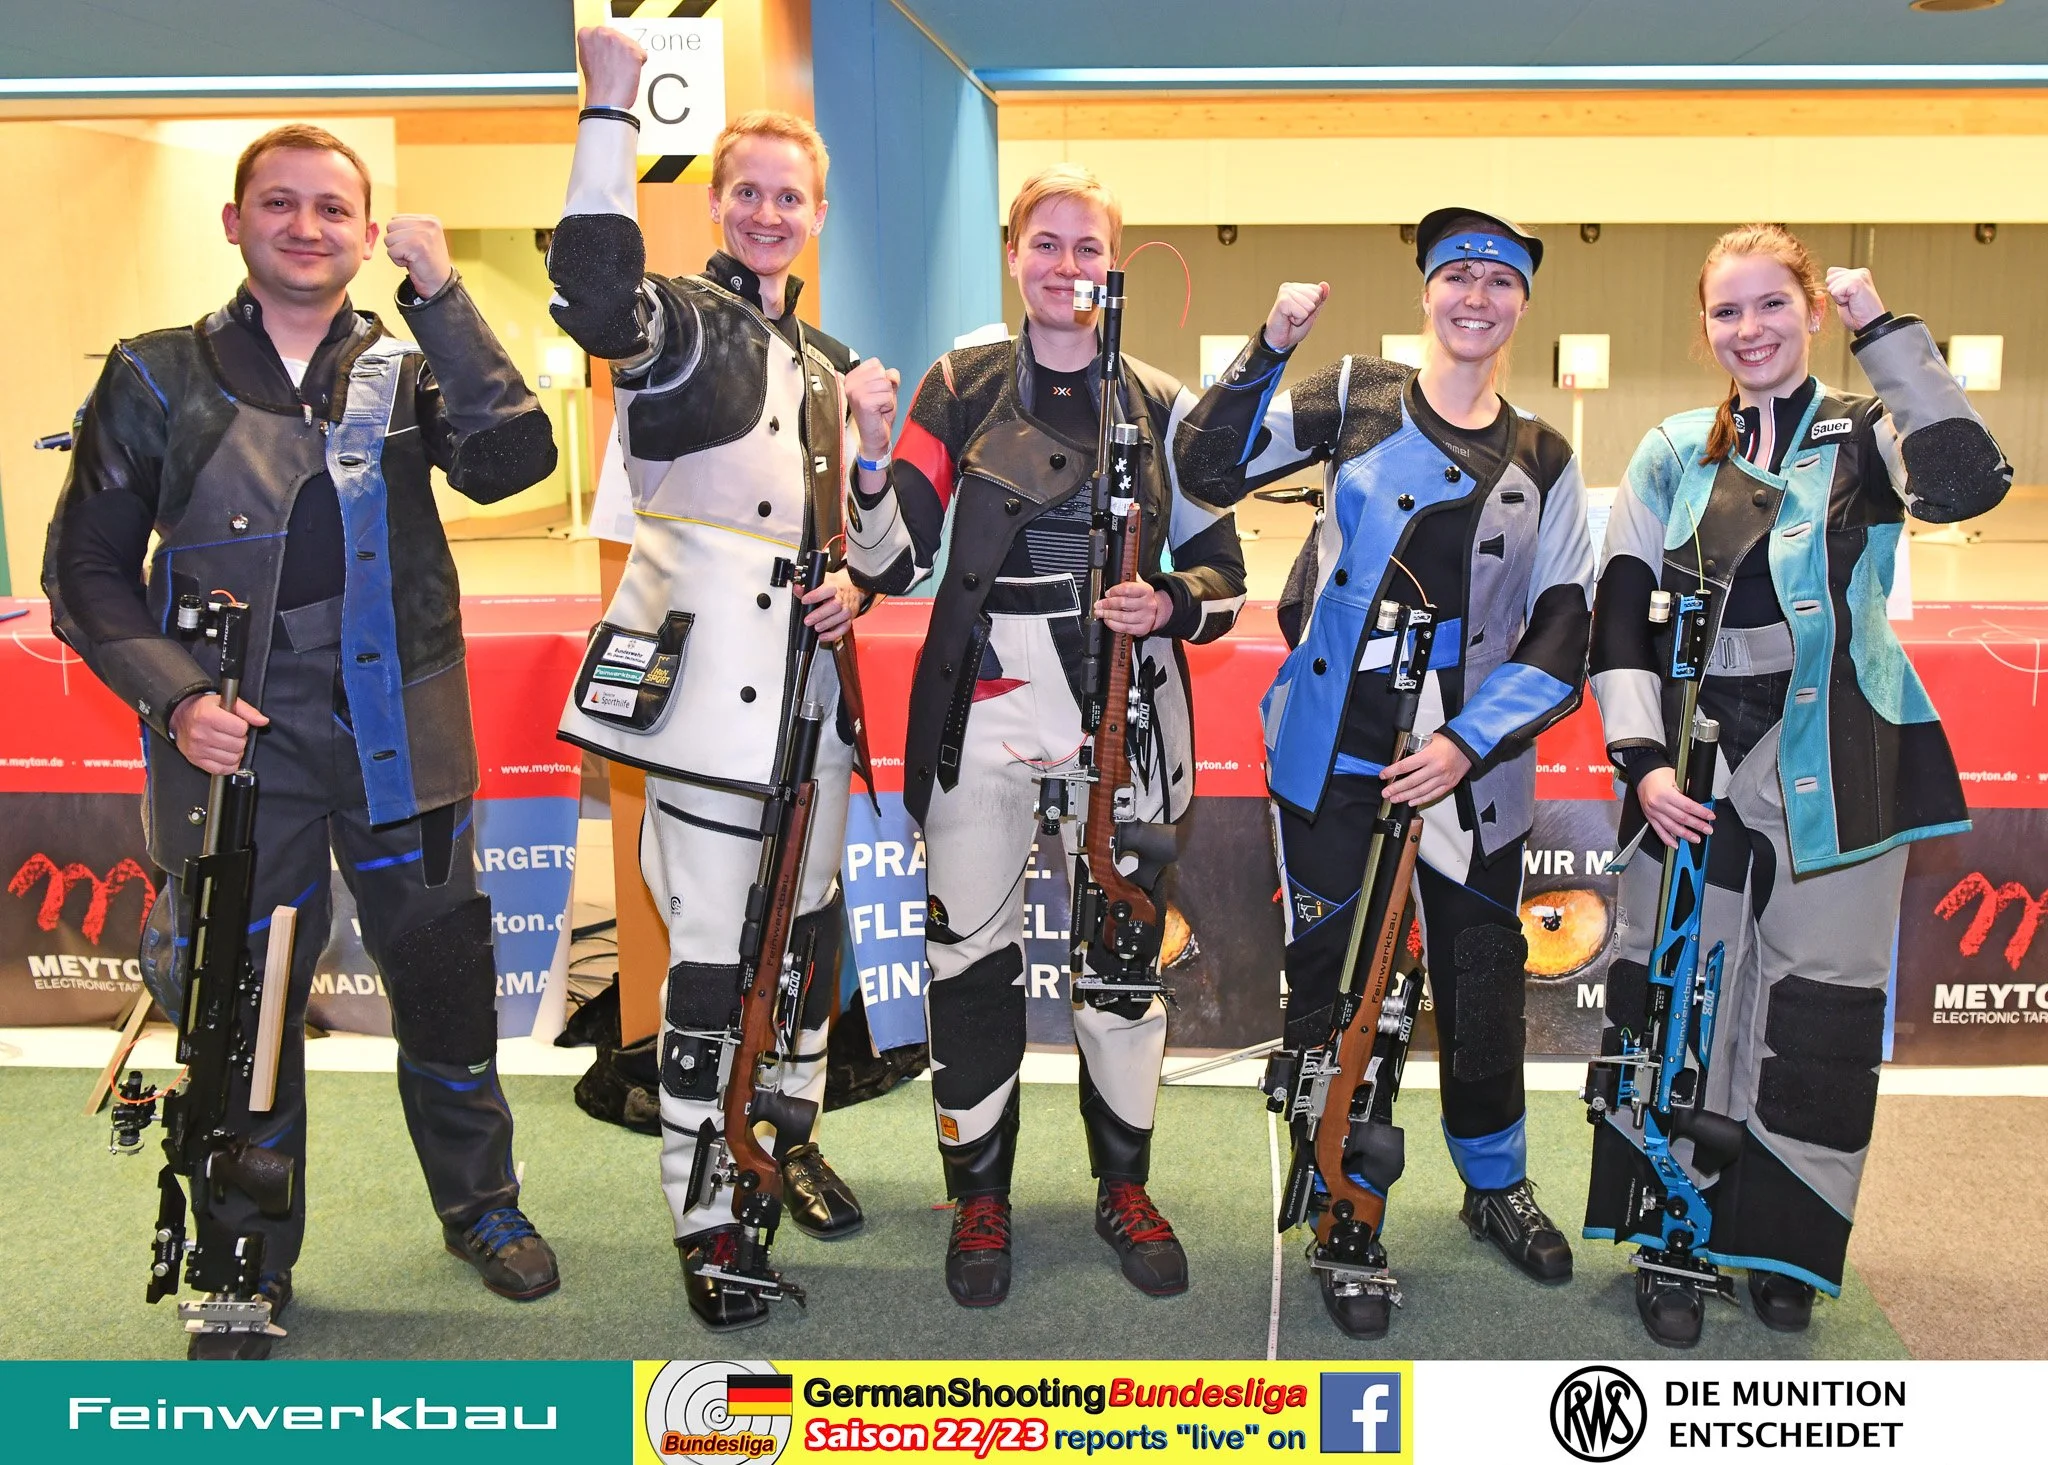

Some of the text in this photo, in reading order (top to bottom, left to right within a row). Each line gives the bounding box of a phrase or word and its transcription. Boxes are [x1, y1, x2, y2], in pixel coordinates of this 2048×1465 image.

[647, 73, 690, 125] C
[1813, 422, 1850, 436] Sauer
[1442, 441, 1470, 458] mmel
[602, 697, 630, 708] Sporthilfe
[1138, 702, 1151, 730] 800
[767, 874, 790, 967] Feinwerkbau
[1371, 911, 1398, 1004] Feinwerkbau
[34, 978, 117, 991] ELECTRONIC
[788, 969, 802, 998] 800
[1676, 967, 1694, 1057] Feinwerkbau
[1702, 989, 1716, 1016] 800
[1399, 1015, 1414, 1043] 800
[1932, 1011, 2020, 1024] ELECTRONIC
